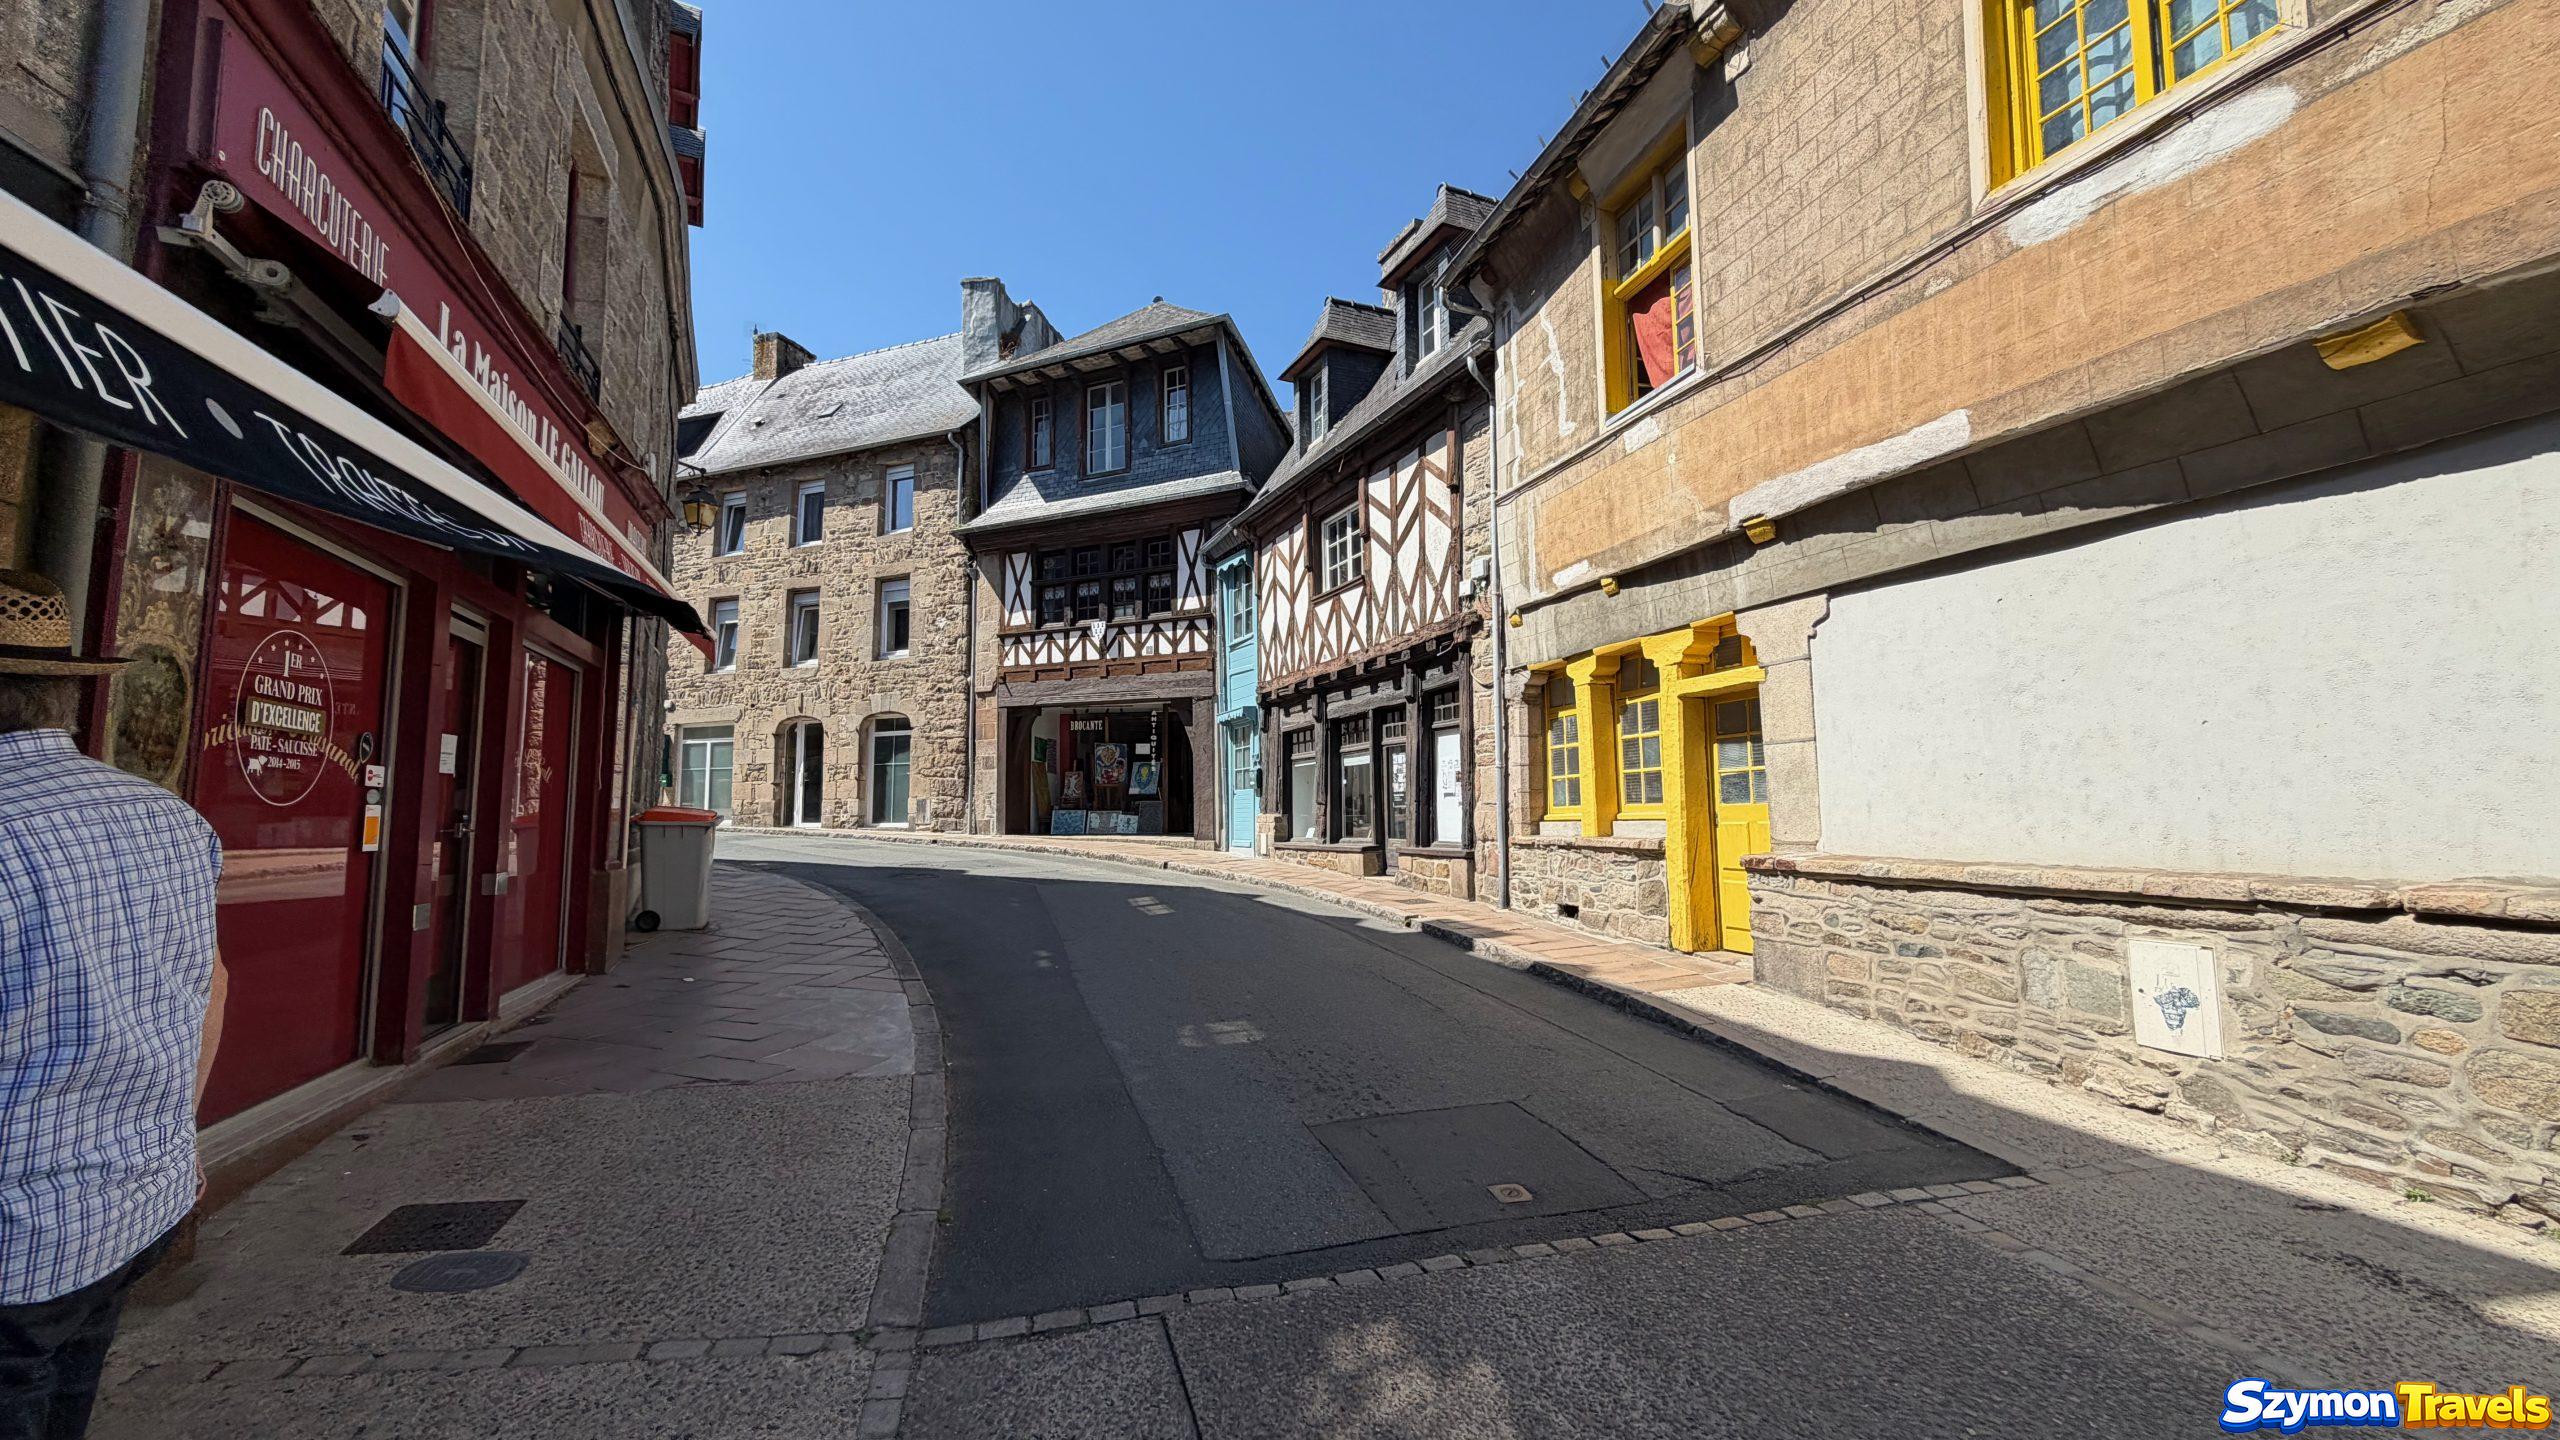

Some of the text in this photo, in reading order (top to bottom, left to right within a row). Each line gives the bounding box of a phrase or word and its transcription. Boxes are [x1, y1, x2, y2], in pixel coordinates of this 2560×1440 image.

[256, 107, 390, 287] CHARCUTERIE
[440, 301, 467, 370] La
[474, 341, 538, 443] Maison
[540, 415, 559, 465] LE
[254, 674, 323, 706] GRAND PRIX
[251, 701, 321, 733] D'EXCELLENCE
[1070, 720, 1103, 731] BROCANTE
